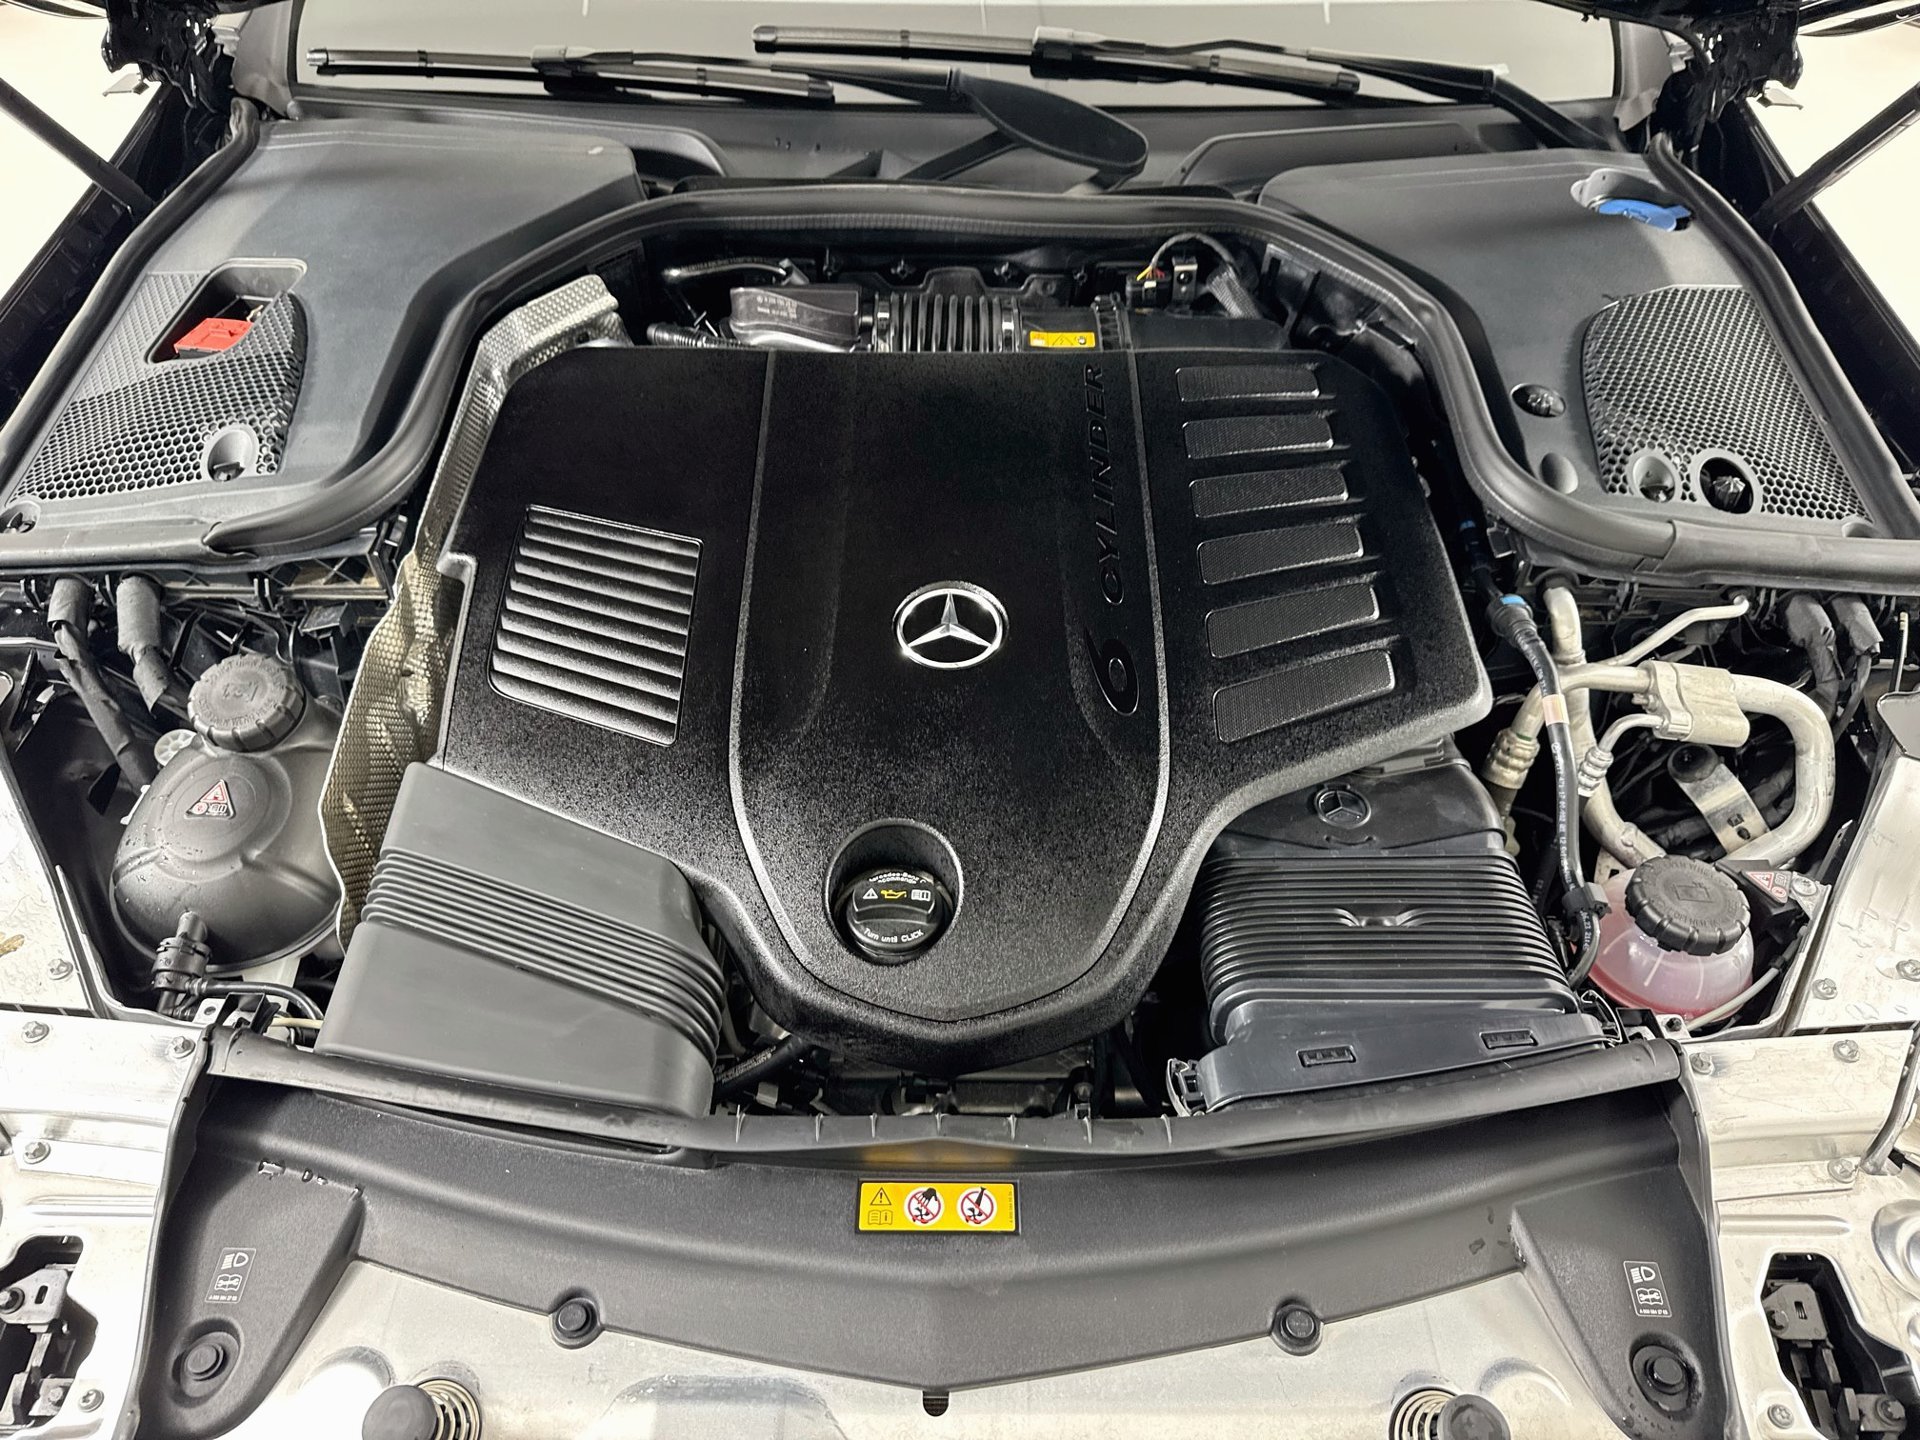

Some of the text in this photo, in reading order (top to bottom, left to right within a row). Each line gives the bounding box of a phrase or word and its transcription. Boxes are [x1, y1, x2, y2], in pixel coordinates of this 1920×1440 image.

[1084, 363, 1125, 605] CYLINDER
[864, 927, 924, 943] Turn until CLICK
